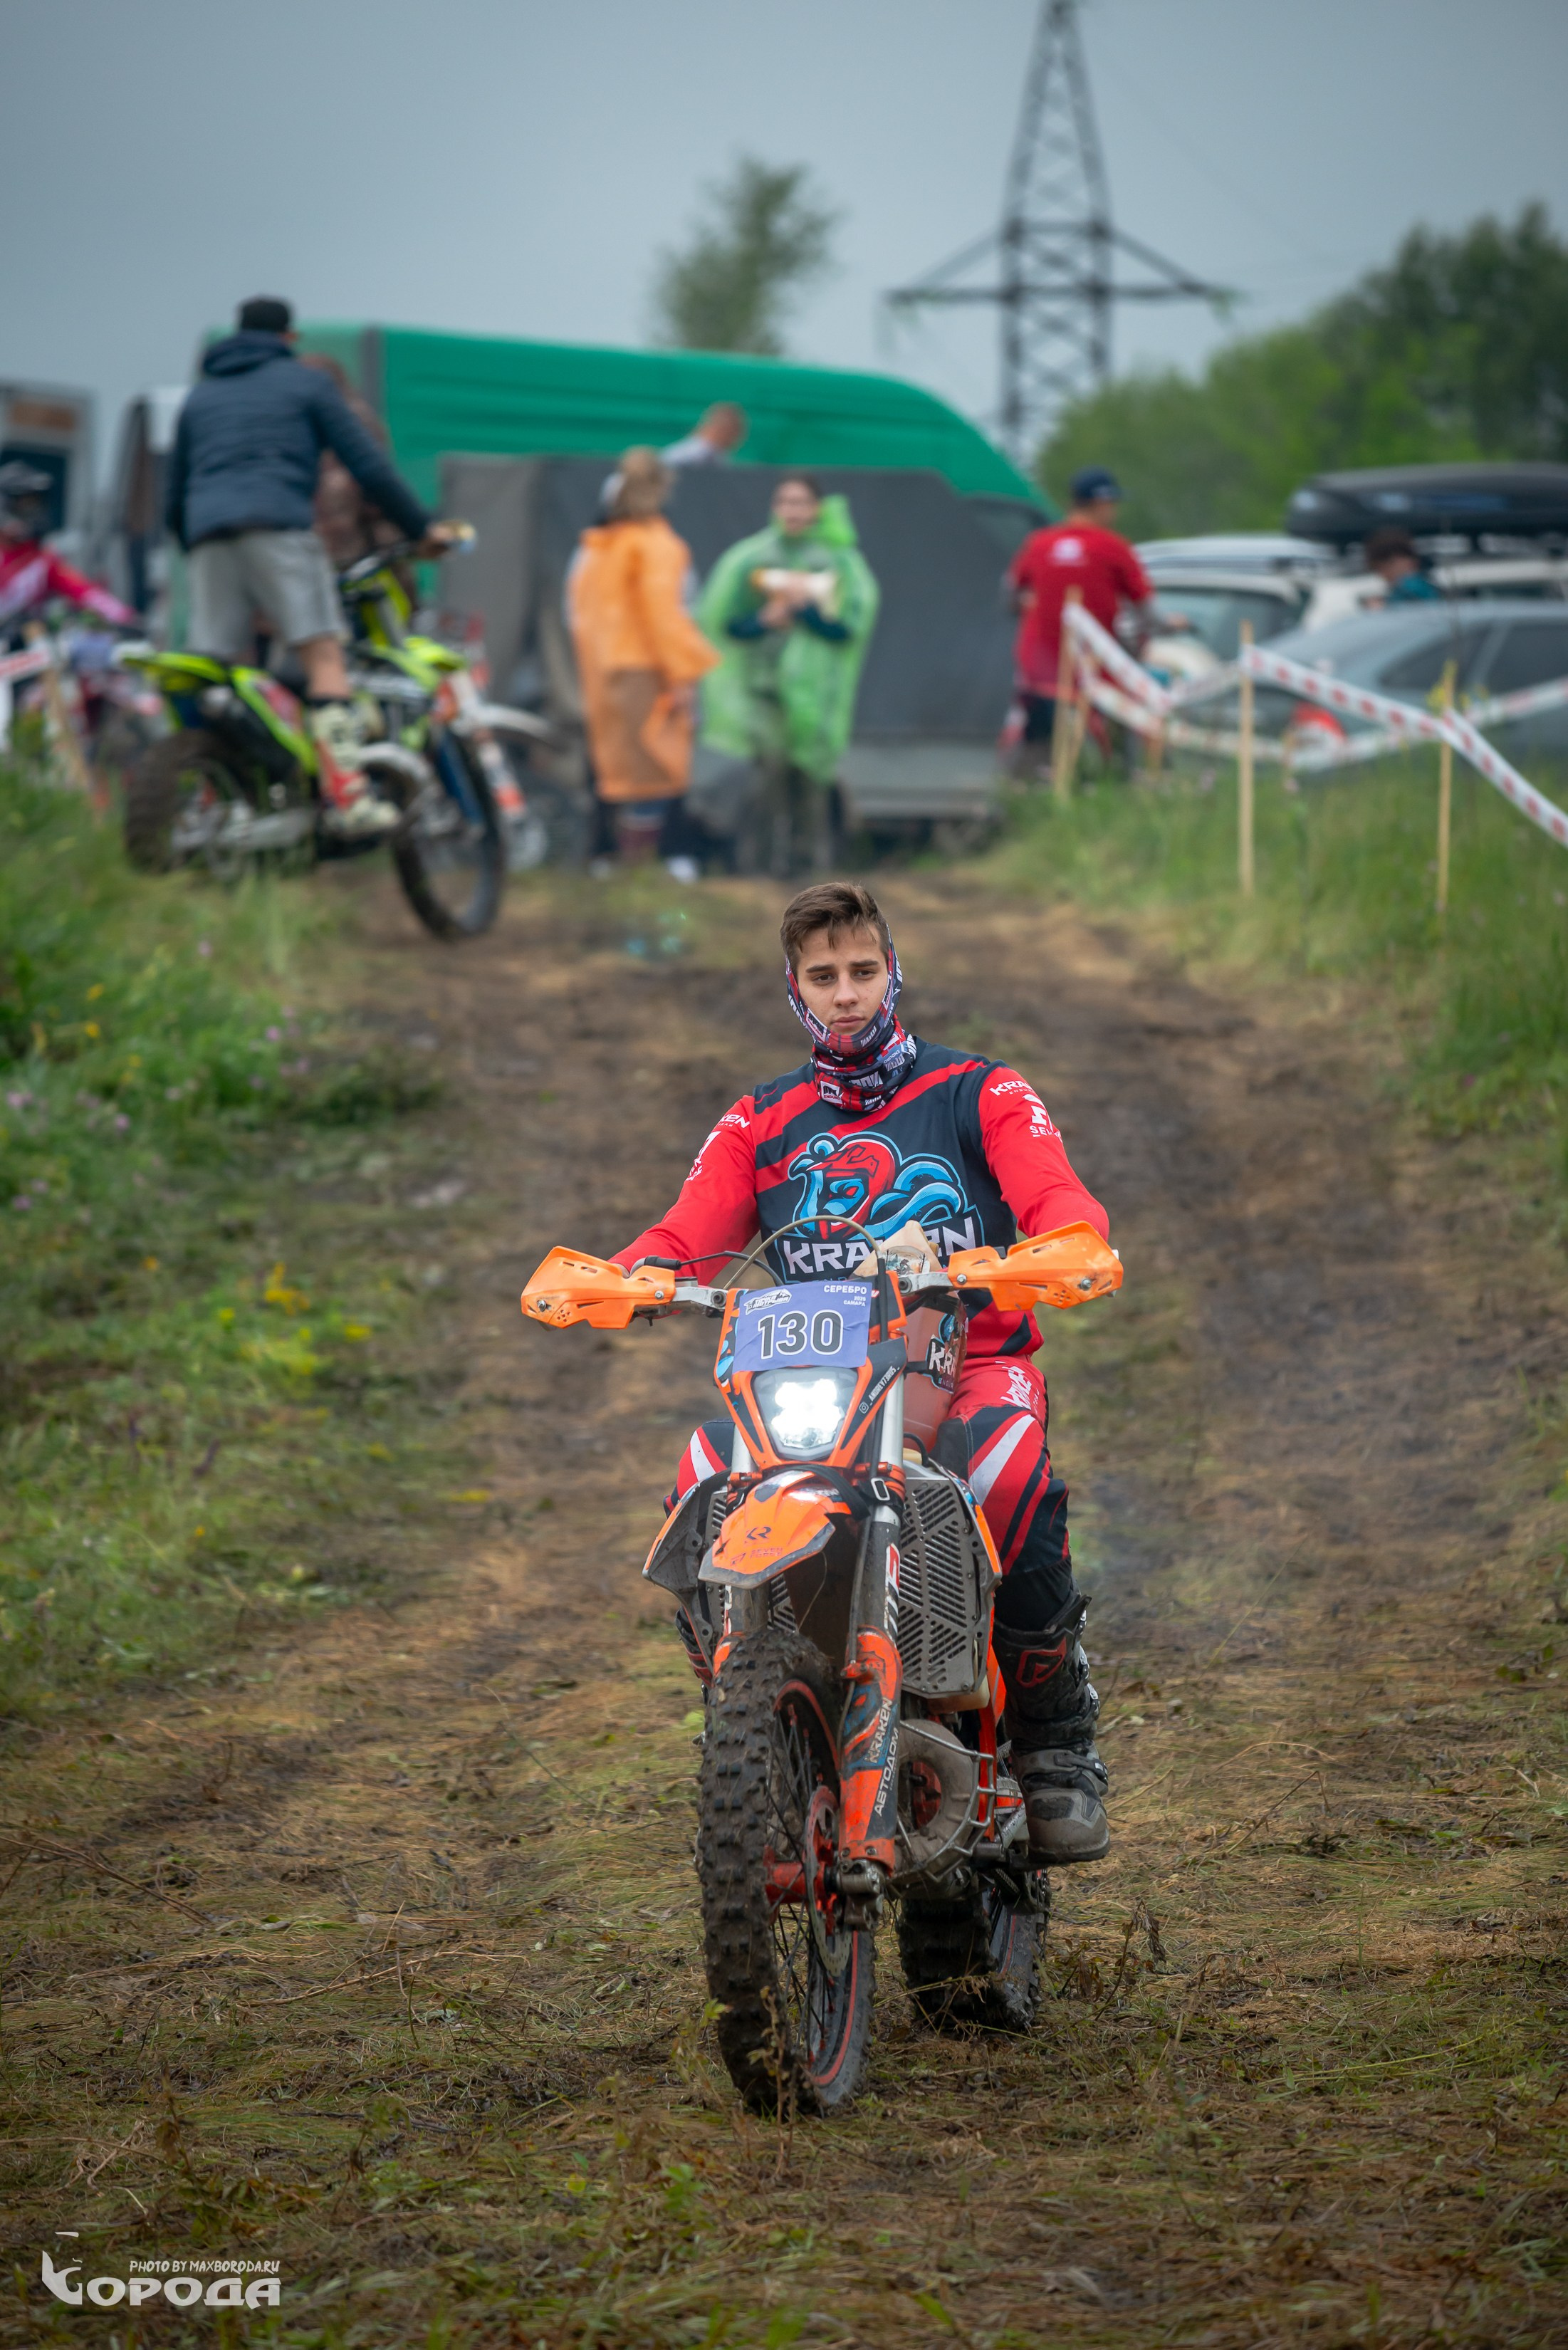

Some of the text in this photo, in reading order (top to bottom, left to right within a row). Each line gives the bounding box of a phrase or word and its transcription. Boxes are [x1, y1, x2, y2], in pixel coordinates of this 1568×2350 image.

[823, 1285, 867, 1295] СЕРЕБРО
[758, 1310, 844, 1359] 130
[864, 1697, 893, 1764] KRAKEN
